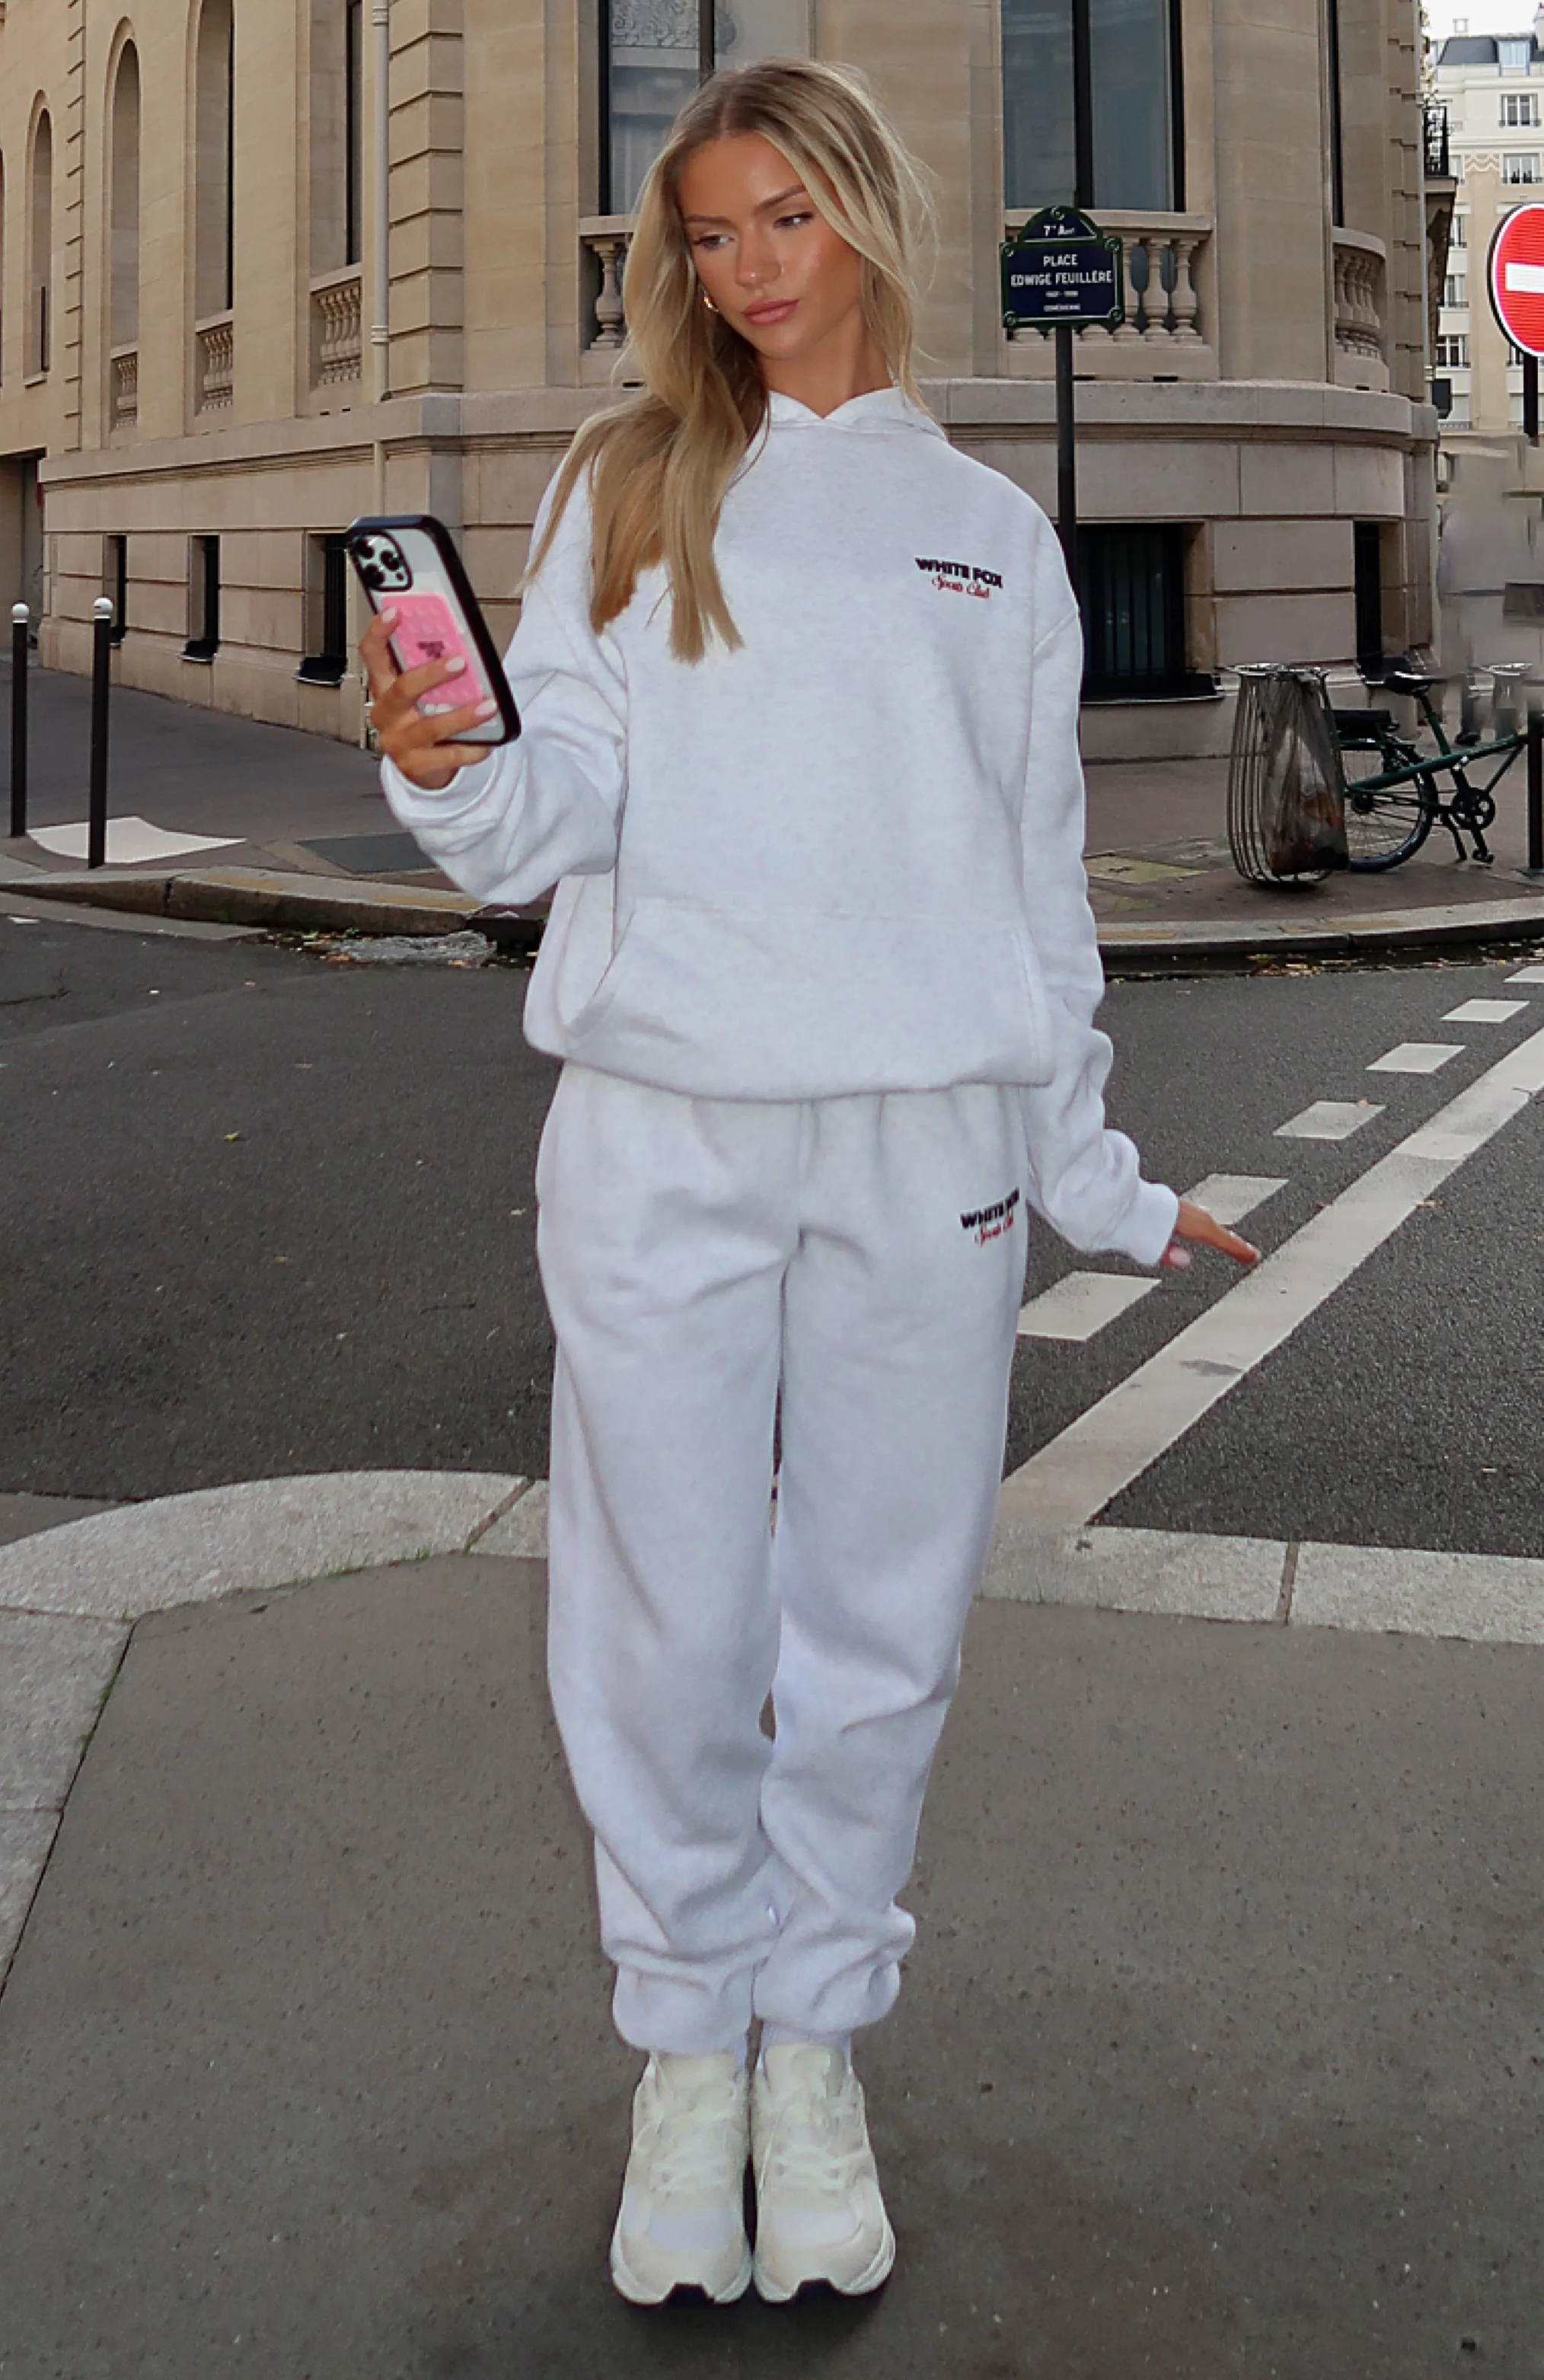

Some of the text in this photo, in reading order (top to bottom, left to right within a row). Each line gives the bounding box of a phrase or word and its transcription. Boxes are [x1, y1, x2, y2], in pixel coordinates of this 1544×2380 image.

[1043, 254, 1078, 267] PLACE
[1010, 273, 1052, 287] EDWIGE
[915, 557, 1003, 589] WHITE FOX
